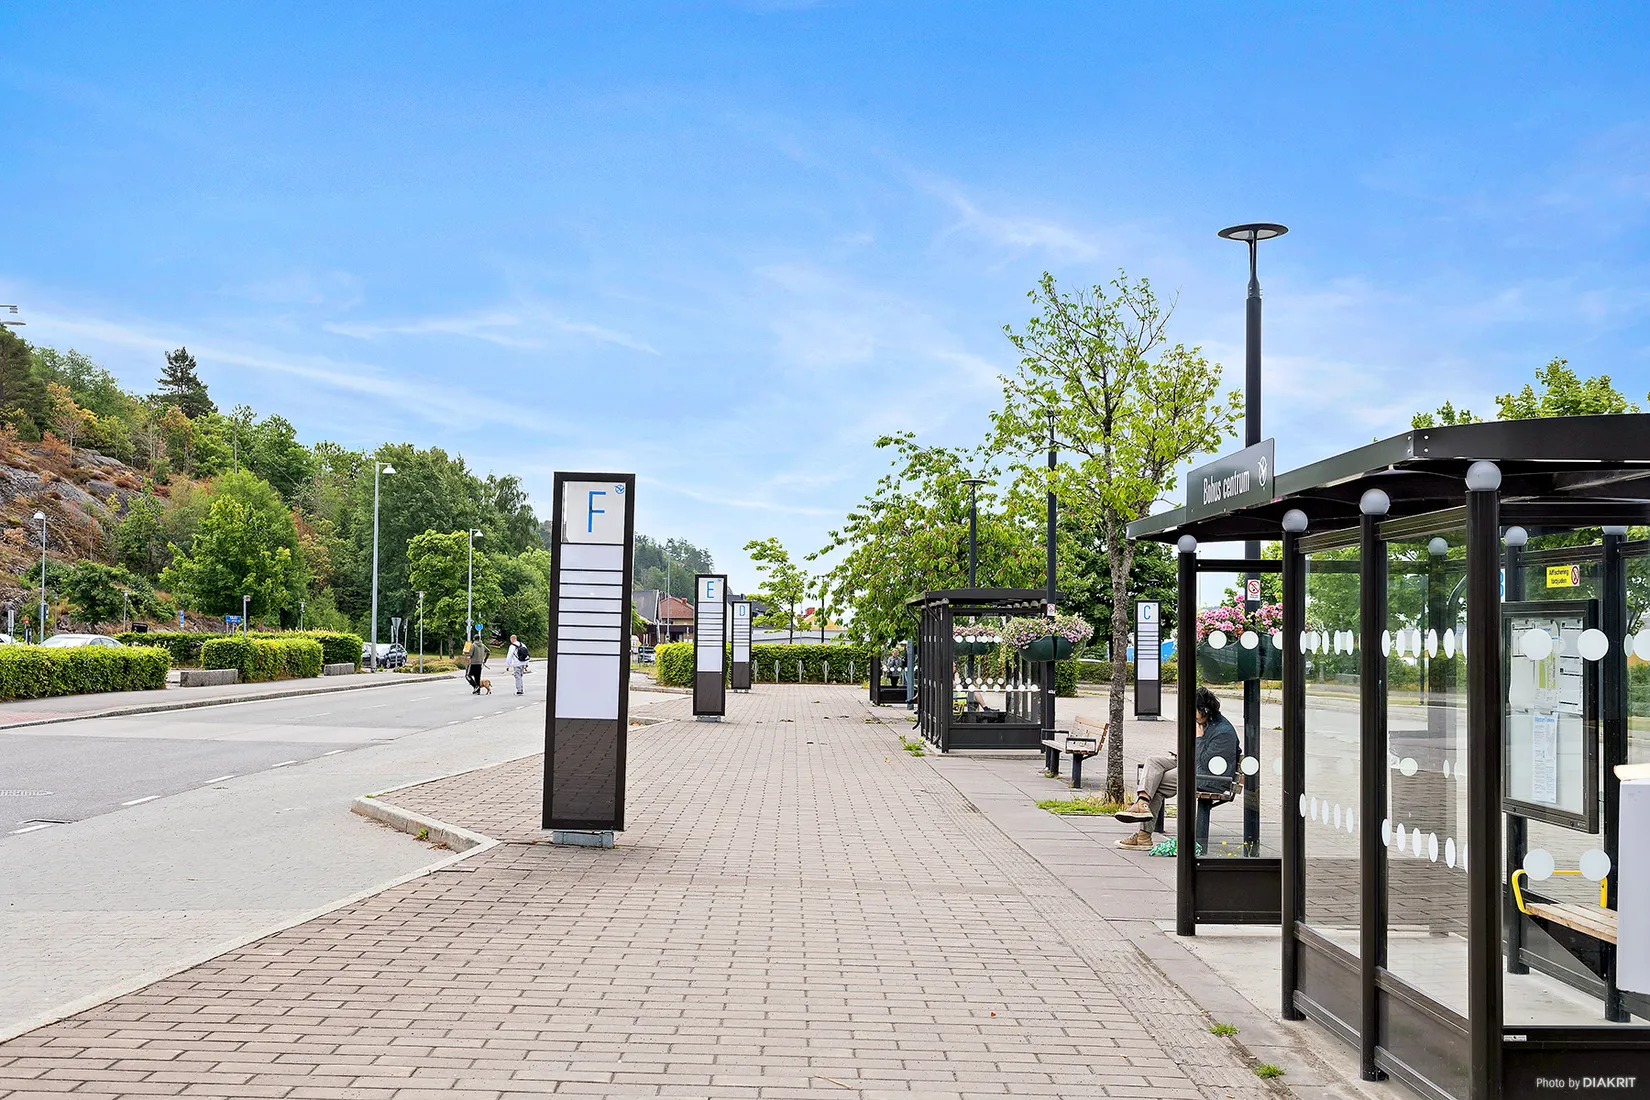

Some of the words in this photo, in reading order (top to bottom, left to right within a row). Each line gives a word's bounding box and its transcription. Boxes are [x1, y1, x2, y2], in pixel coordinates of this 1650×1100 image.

[1203, 475, 1221, 505] Bohus
[1223, 470, 1250, 499] centrum
[588, 491, 606, 533] F
[706, 581, 715, 599] E
[739, 605, 746, 617] D
[1143, 604, 1151, 620] C
